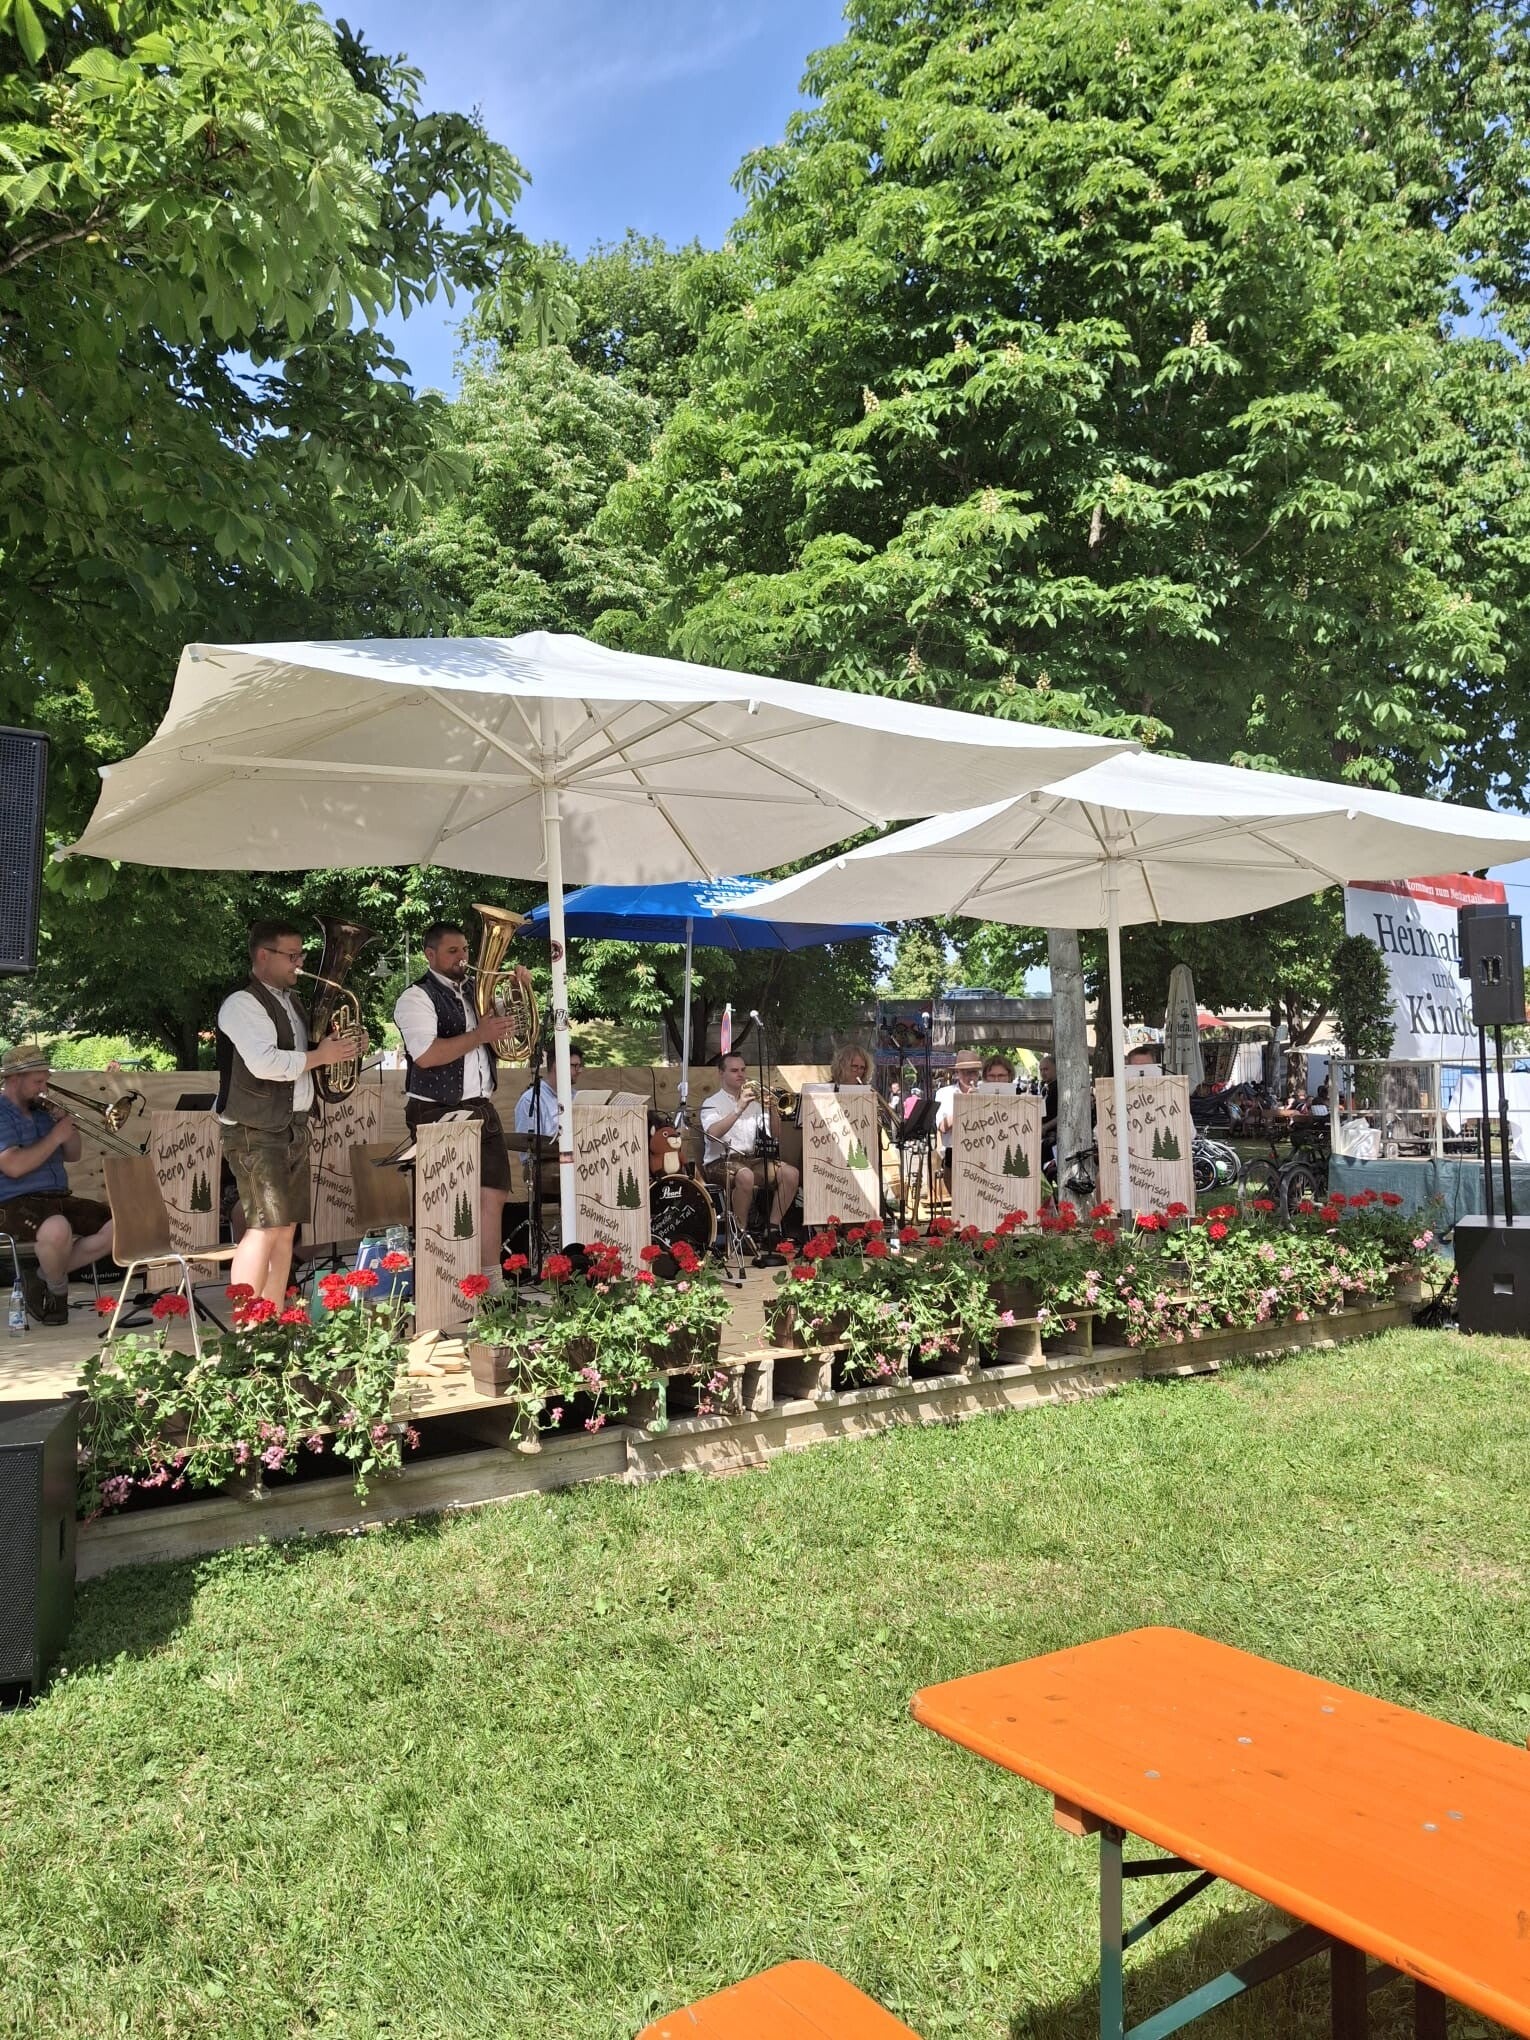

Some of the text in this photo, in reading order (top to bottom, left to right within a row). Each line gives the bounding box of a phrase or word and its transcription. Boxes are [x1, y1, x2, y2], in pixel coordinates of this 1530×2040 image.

[1373, 913, 1461, 962] Heimat
[1431, 972, 1456, 990] und
[311, 1104, 354, 1133] Kapelle
[810, 1109, 850, 1131] Kapelle
[1106, 1093, 1155, 1120] Kpelle
[1106, 1100, 1181, 1137] Brg & Tal
[345, 1124, 355, 1138] &
[354, 1111, 377, 1130] Tal
[810, 1115, 870, 1149] Berg & Tal
[962, 1110, 1009, 1133] Kapelle
[158, 1131, 196, 1162] Kapelle
[577, 1127, 620, 1158] Kapelle
[960, 1120, 1033, 1152] Berg & Tal
[157, 1142, 216, 1186] Berg & Tal
[422, 1146, 457, 1184] Kapelle
[577, 1136, 642, 1181] Berg & Tal
[422, 1154, 475, 1211] Berg & Tal
[813, 1164, 849, 1186] Böhmisch
[962, 1168, 1005, 1194] Böhmisch
[660, 1186, 683, 1199] Pearl
[825, 1183, 860, 1203] Mährisch
[976, 1188, 1018, 1212] Mährisch
[580, 1204, 619, 1232] Böhmisch
[843, 1202, 871, 1219] Modern
[424, 1238, 456, 1266] Böhmisch
[451, 1292, 475, 1314] Modern
